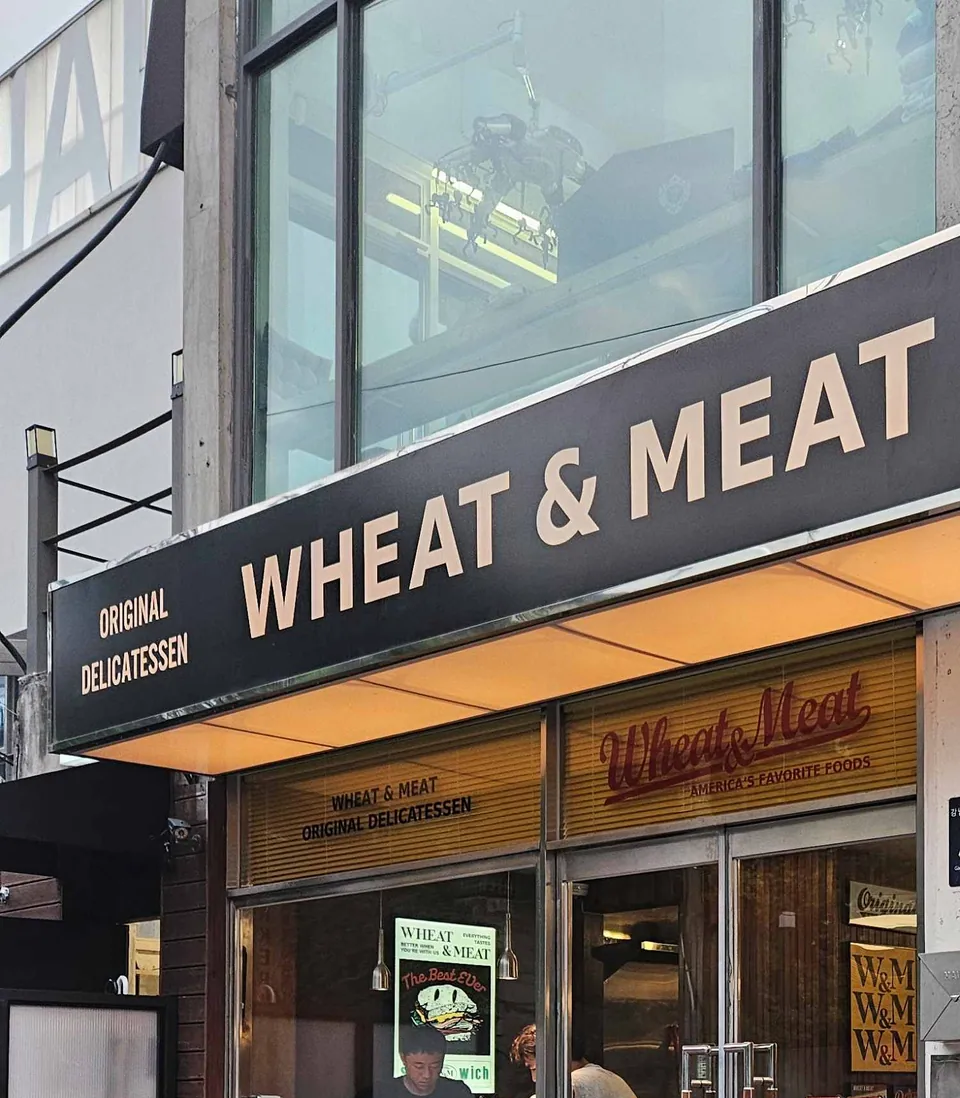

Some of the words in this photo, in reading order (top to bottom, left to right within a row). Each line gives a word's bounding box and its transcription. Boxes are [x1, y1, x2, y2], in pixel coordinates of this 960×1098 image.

[240, 471, 510, 639] WHEAT
[535, 447, 600, 546] &
[629, 317, 935, 520] MEAT
[99, 587, 169, 639] ORIGINAL
[81, 632, 188, 695] DELICATESSEN
[332, 787, 379, 811] WHEAT
[384, 785, 393, 803] &
[399, 776, 438, 798] MEAT
[689, 777, 755, 798] AMERICA'S
[759, 764, 821, 786] FAVORITE
[825, 755, 871, 775] FOODS
[302, 818, 364, 841] ORIGINAL
[368, 795, 472, 831] DELICATESSEN
[400, 926, 454, 943] WHEAT
[442, 945, 451, 957] &
[453, 946, 491, 960] MEAT
[402, 972, 428, 990] The
[428, 967, 457, 981] Best
[852, 955, 915, 993] W&M
[853, 991, 915, 1029] W&M
[853, 1029, 915, 1066] W&M
[459, 1066, 488, 1080] wich
